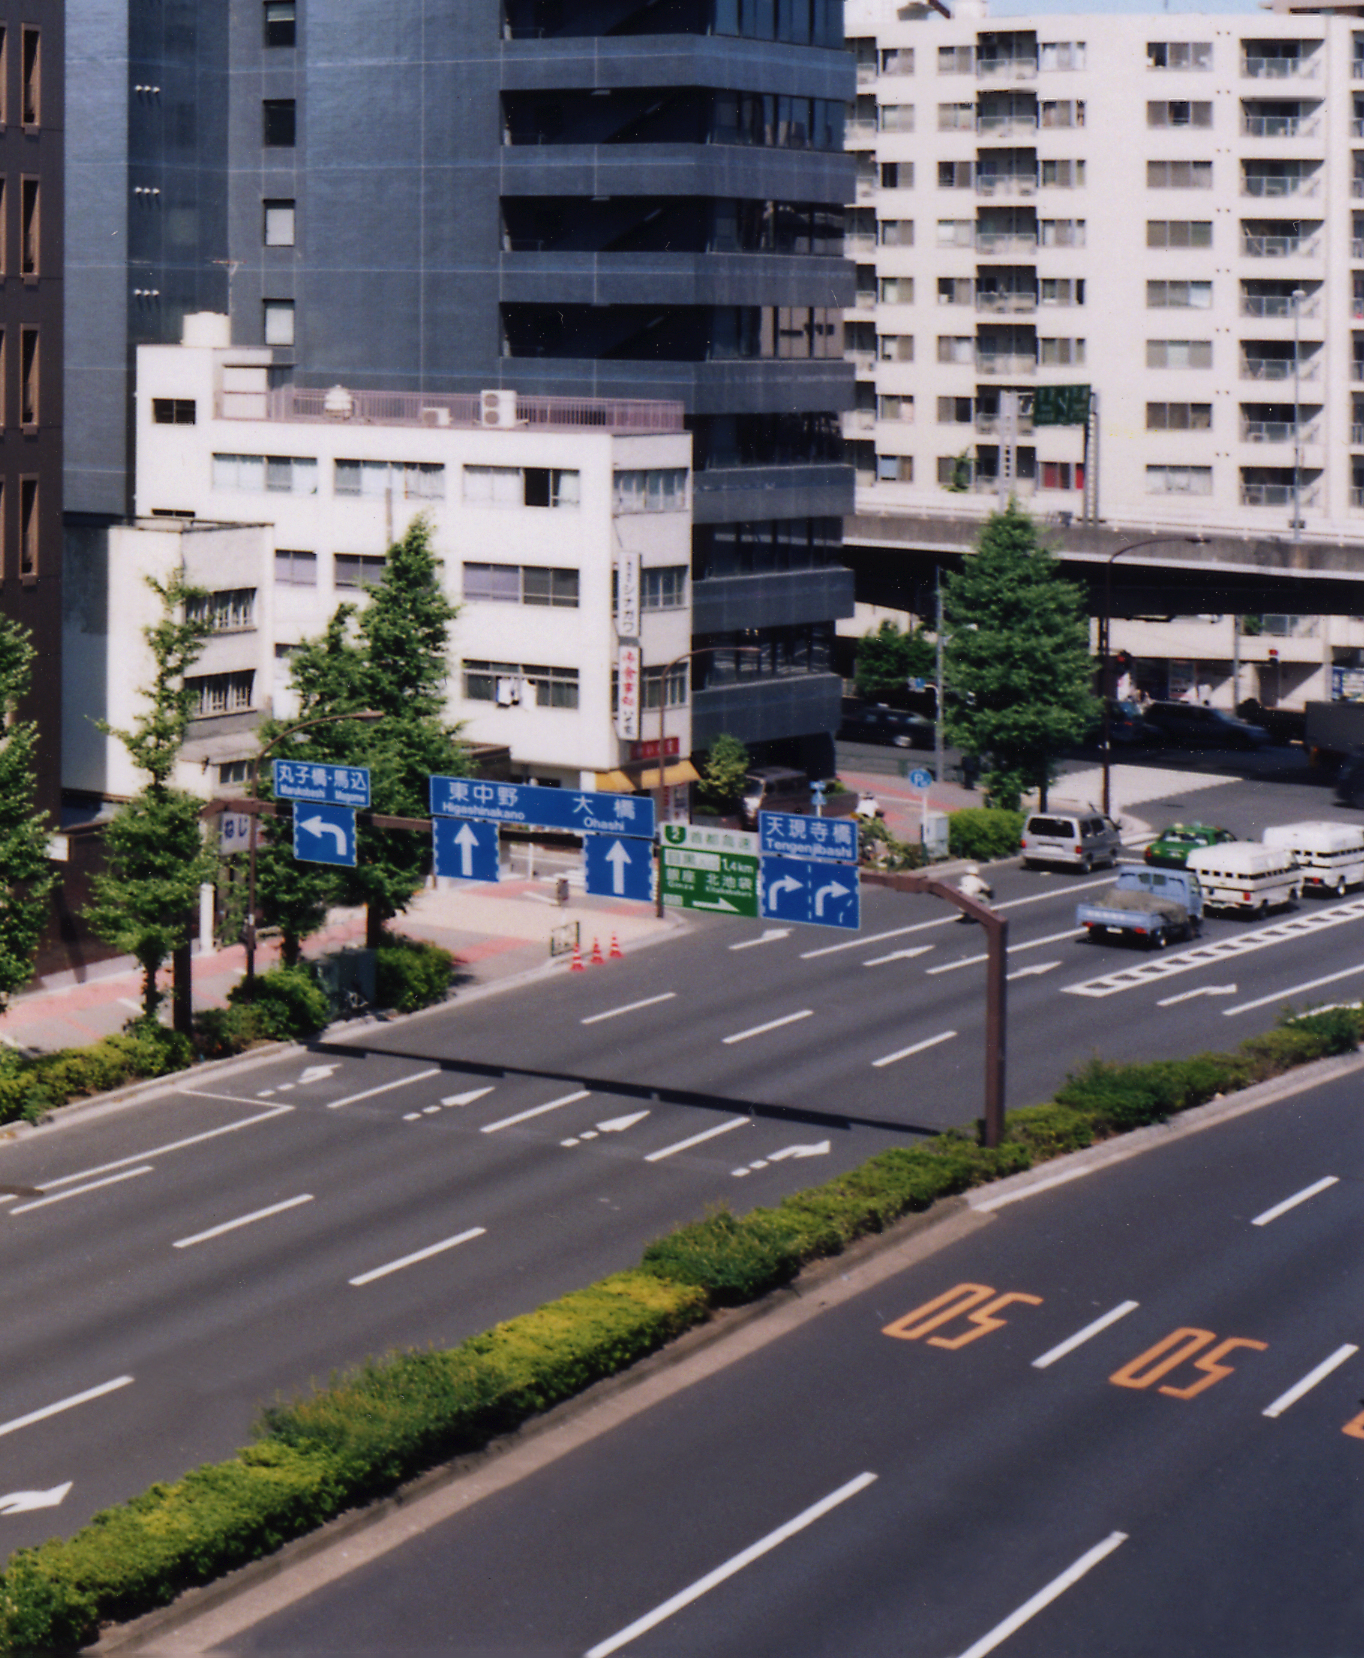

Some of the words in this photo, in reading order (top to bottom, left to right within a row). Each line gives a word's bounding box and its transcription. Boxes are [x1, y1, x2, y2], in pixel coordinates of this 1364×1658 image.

[449, 782, 518, 807] 東中野
[442, 801, 525, 821] Higashinakano
[584, 816, 625, 832] Ohashi
[766, 816, 852, 845] 天現寺橋
[766, 838, 852, 858] Tengenjibashi
